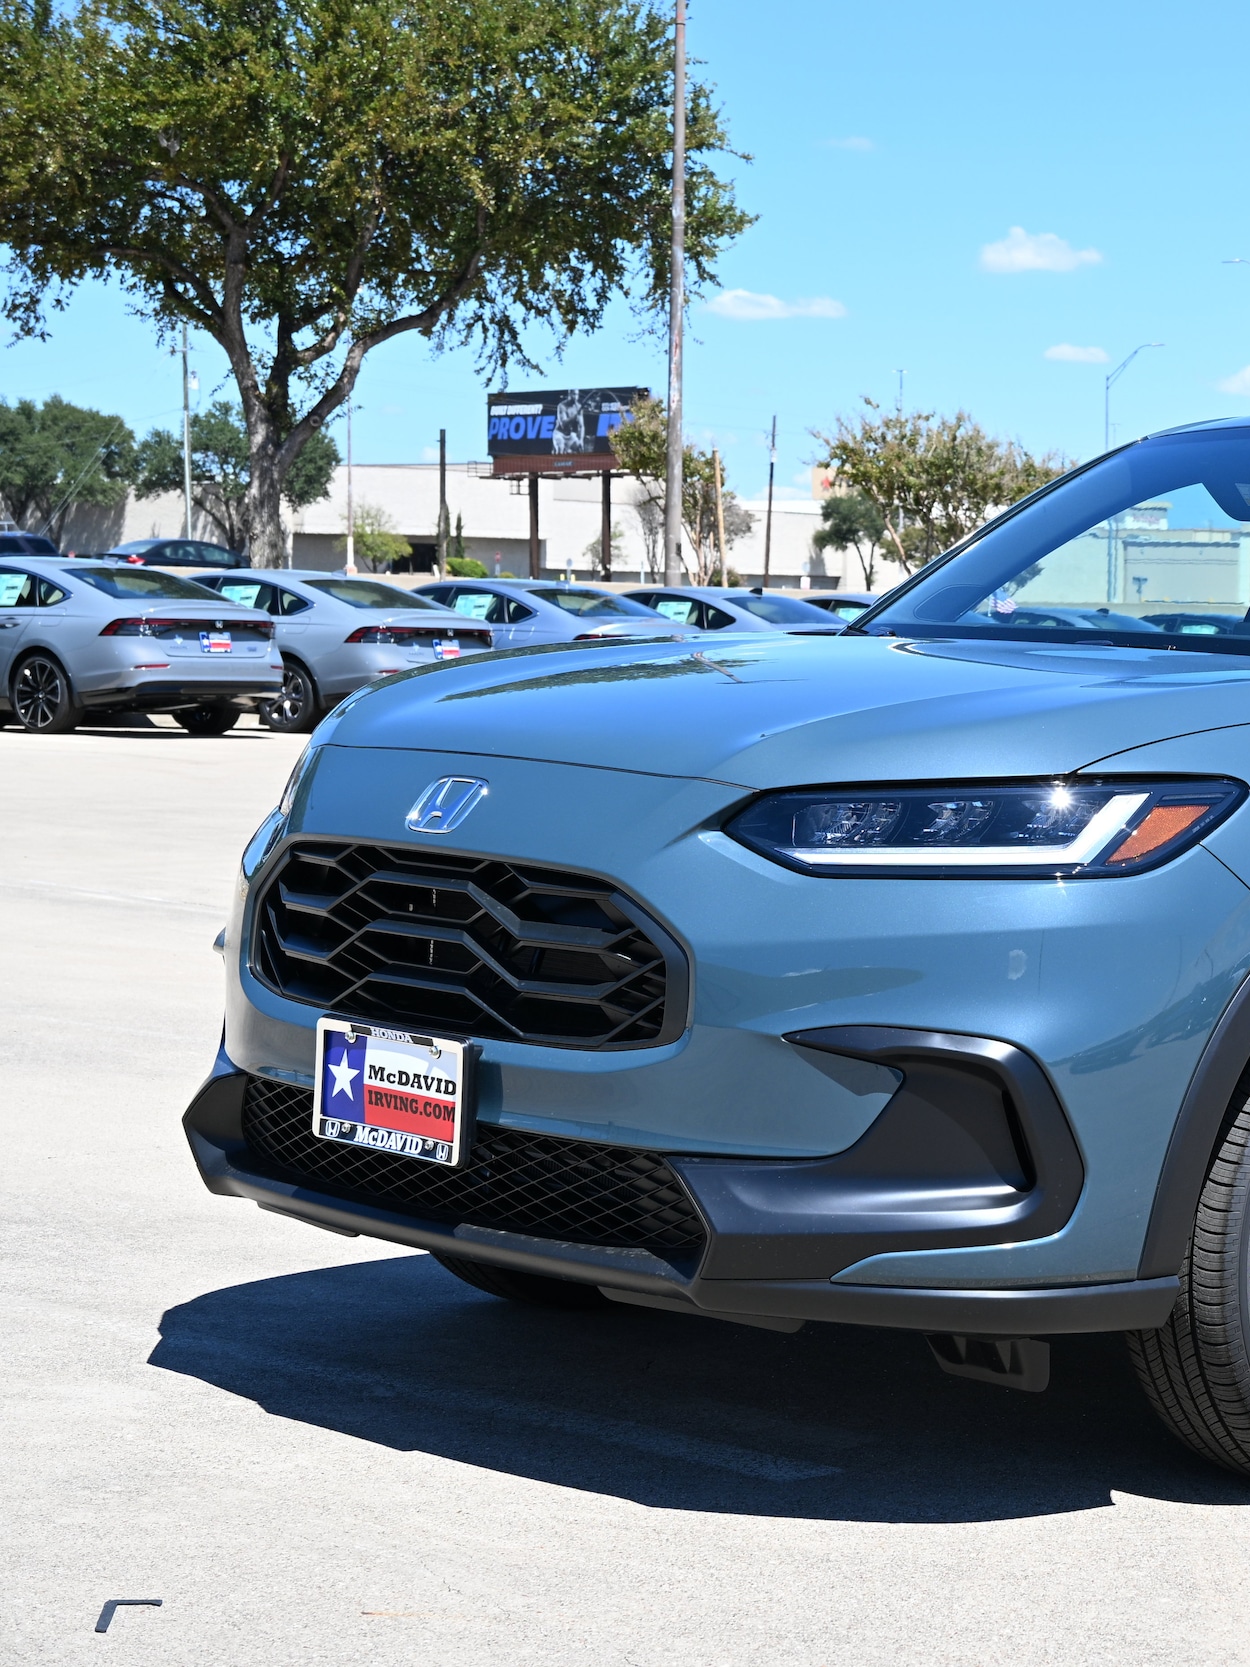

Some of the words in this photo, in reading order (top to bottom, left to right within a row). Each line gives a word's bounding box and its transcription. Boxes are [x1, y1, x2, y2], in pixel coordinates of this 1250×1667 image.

[488, 415, 556, 440] PROVE
[371, 1028, 414, 1044] HONDA
[368, 1064, 457, 1096] McDAVID
[368, 1090, 456, 1123] IRVING.COM
[353, 1125, 423, 1154] McDAVID
